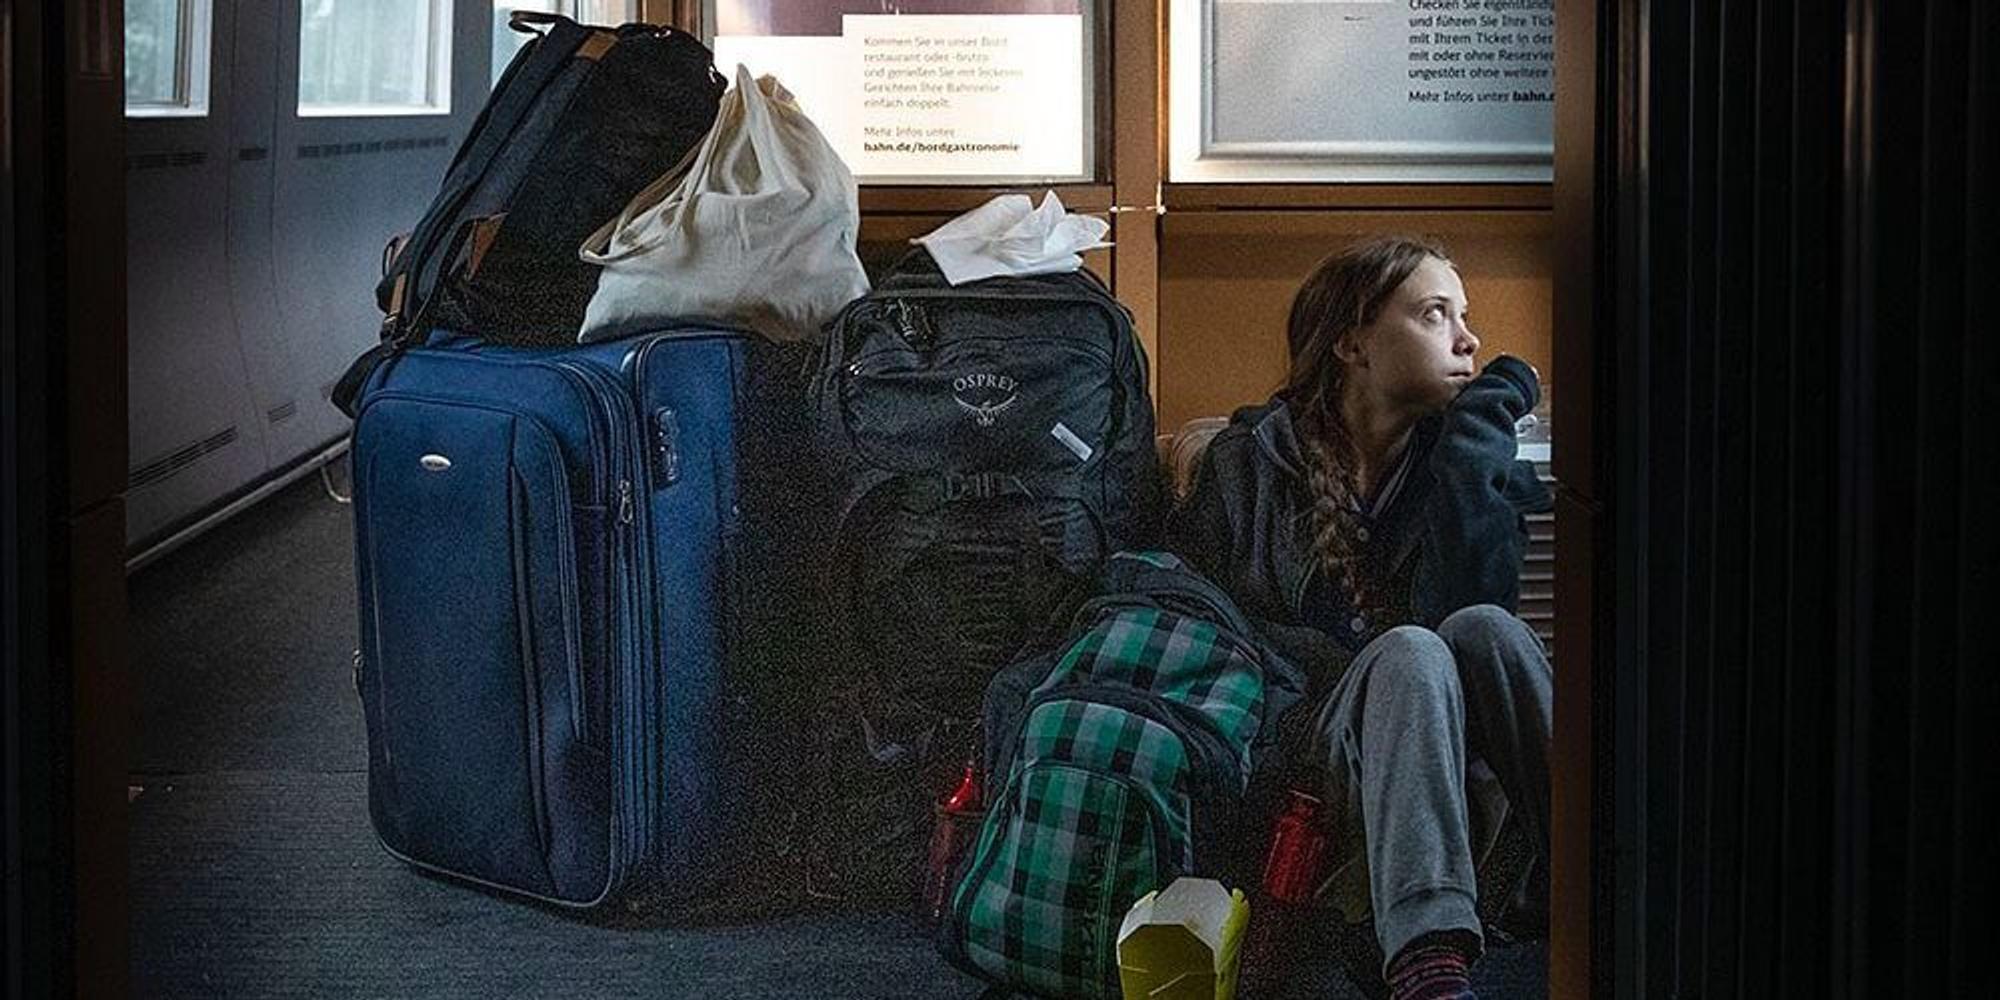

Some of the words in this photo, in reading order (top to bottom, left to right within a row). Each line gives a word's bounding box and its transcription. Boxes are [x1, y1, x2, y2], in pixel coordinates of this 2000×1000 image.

[1408, 15, 1433, 27] und
[1436, 15, 1477, 27] führen
[1480, 15, 1498, 27] Sie
[1502, 15, 1528, 27] Ihre
[863, 36, 912, 47] Kommen
[914, 36, 930, 47] Sie
[1408, 33, 1429, 44] mit
[1434, 32, 1472, 44] Ihrem
[1476, 32, 1513, 44] Ticket
[1517, 32, 1529, 44] in
[863, 53, 921, 62] restaurant
[924, 51, 949, 62] oder
[1408, 49, 1429, 61] mit
[1432, 49, 1461, 61] oder
[1464, 49, 1496, 61] ohne
[863, 66, 885, 77] und
[1408, 66, 1466, 81] ungestört
[1469, 67, 1500, 78] ohne
[863, 82, 918, 94] Gerichten
[863, 98, 904, 108] einfach
[1408, 91, 1440, 103] Mehr
[1443, 91, 1473, 103] Infos
[1477, 92, 1510, 103] unter
[863, 126, 892, 137] Mehr
[896, 126, 923, 137] Infos
[926, 127, 955, 137] unter
[863, 141, 1021, 153] bahn.de/bordgastronomie
[953, 373, 1019, 392] OSPREY
